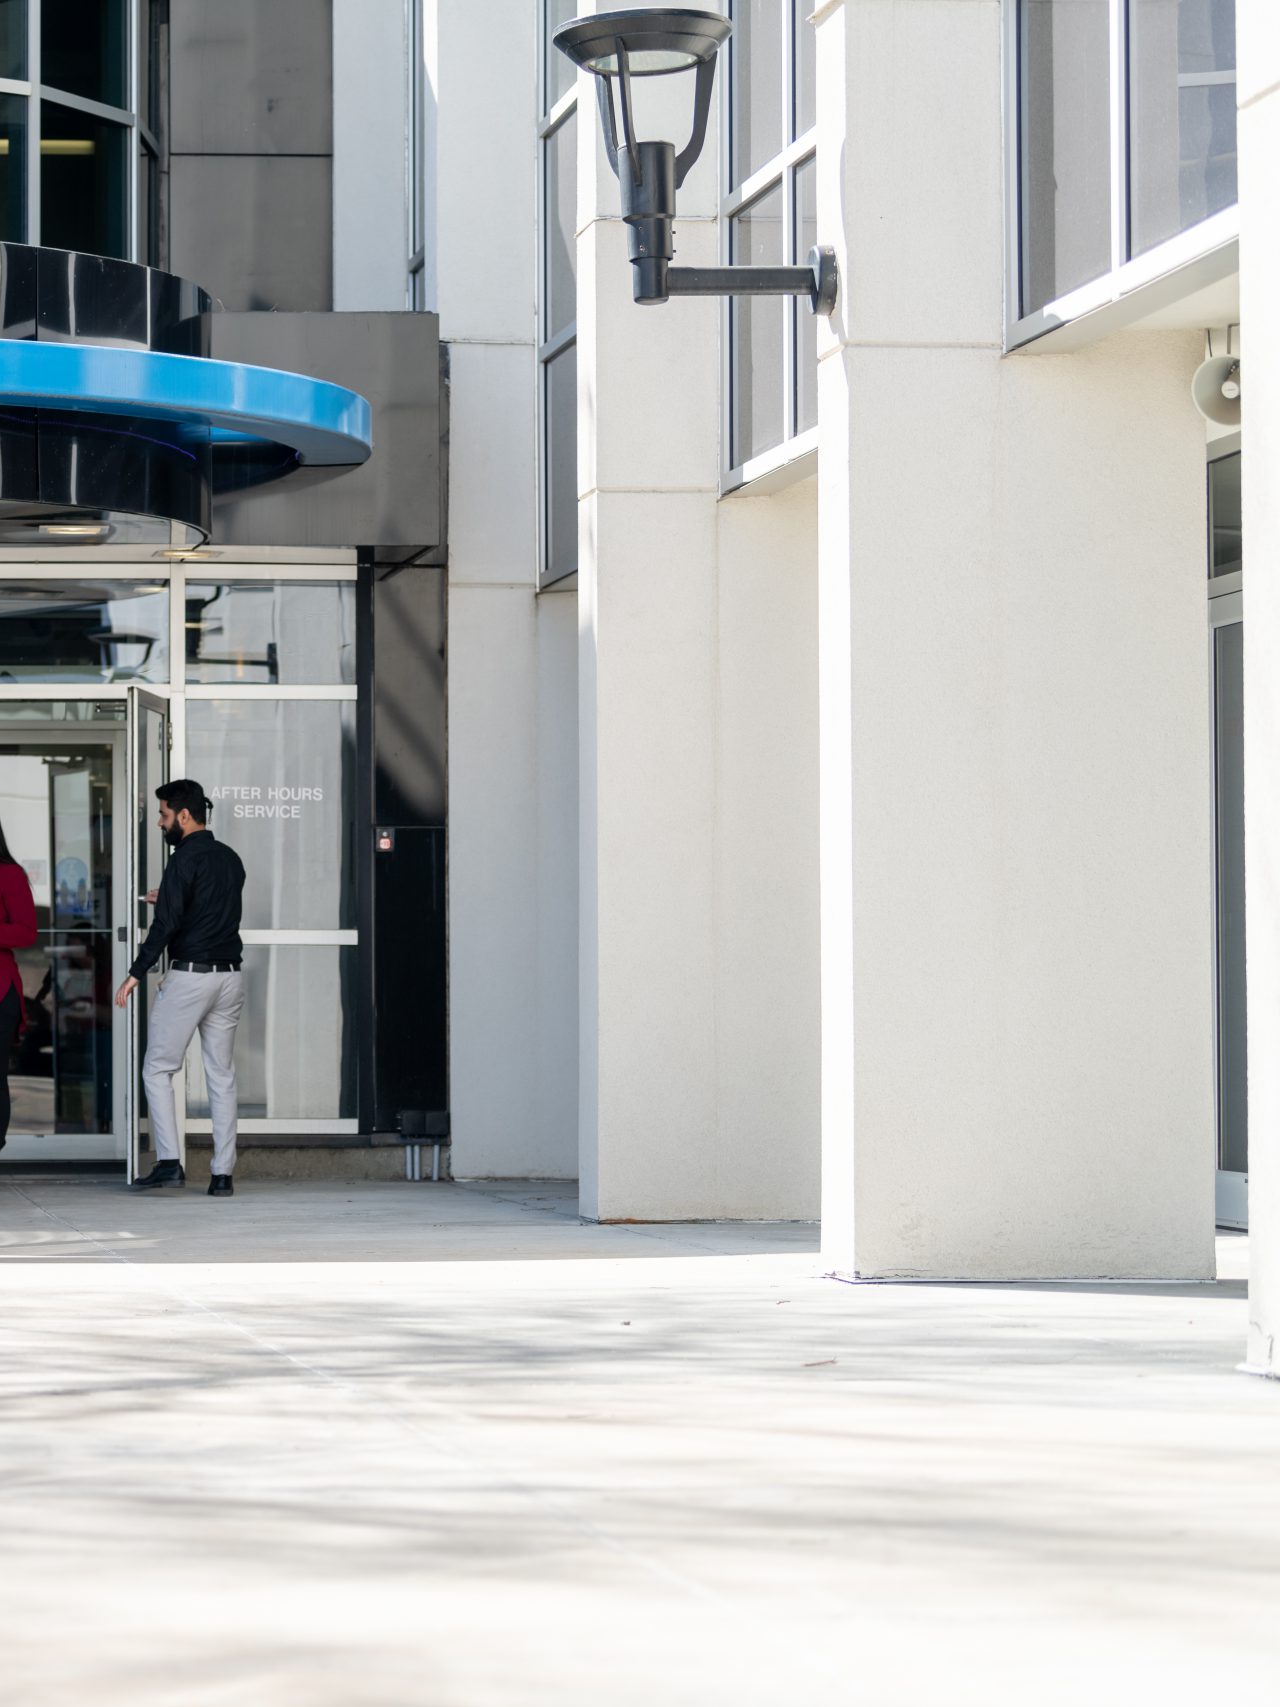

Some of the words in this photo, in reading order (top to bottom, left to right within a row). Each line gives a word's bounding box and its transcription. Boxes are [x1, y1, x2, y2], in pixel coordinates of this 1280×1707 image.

[211, 787, 261, 800] AFTER
[268, 787, 323, 801] HOURS
[234, 805, 301, 818] SERVICE
